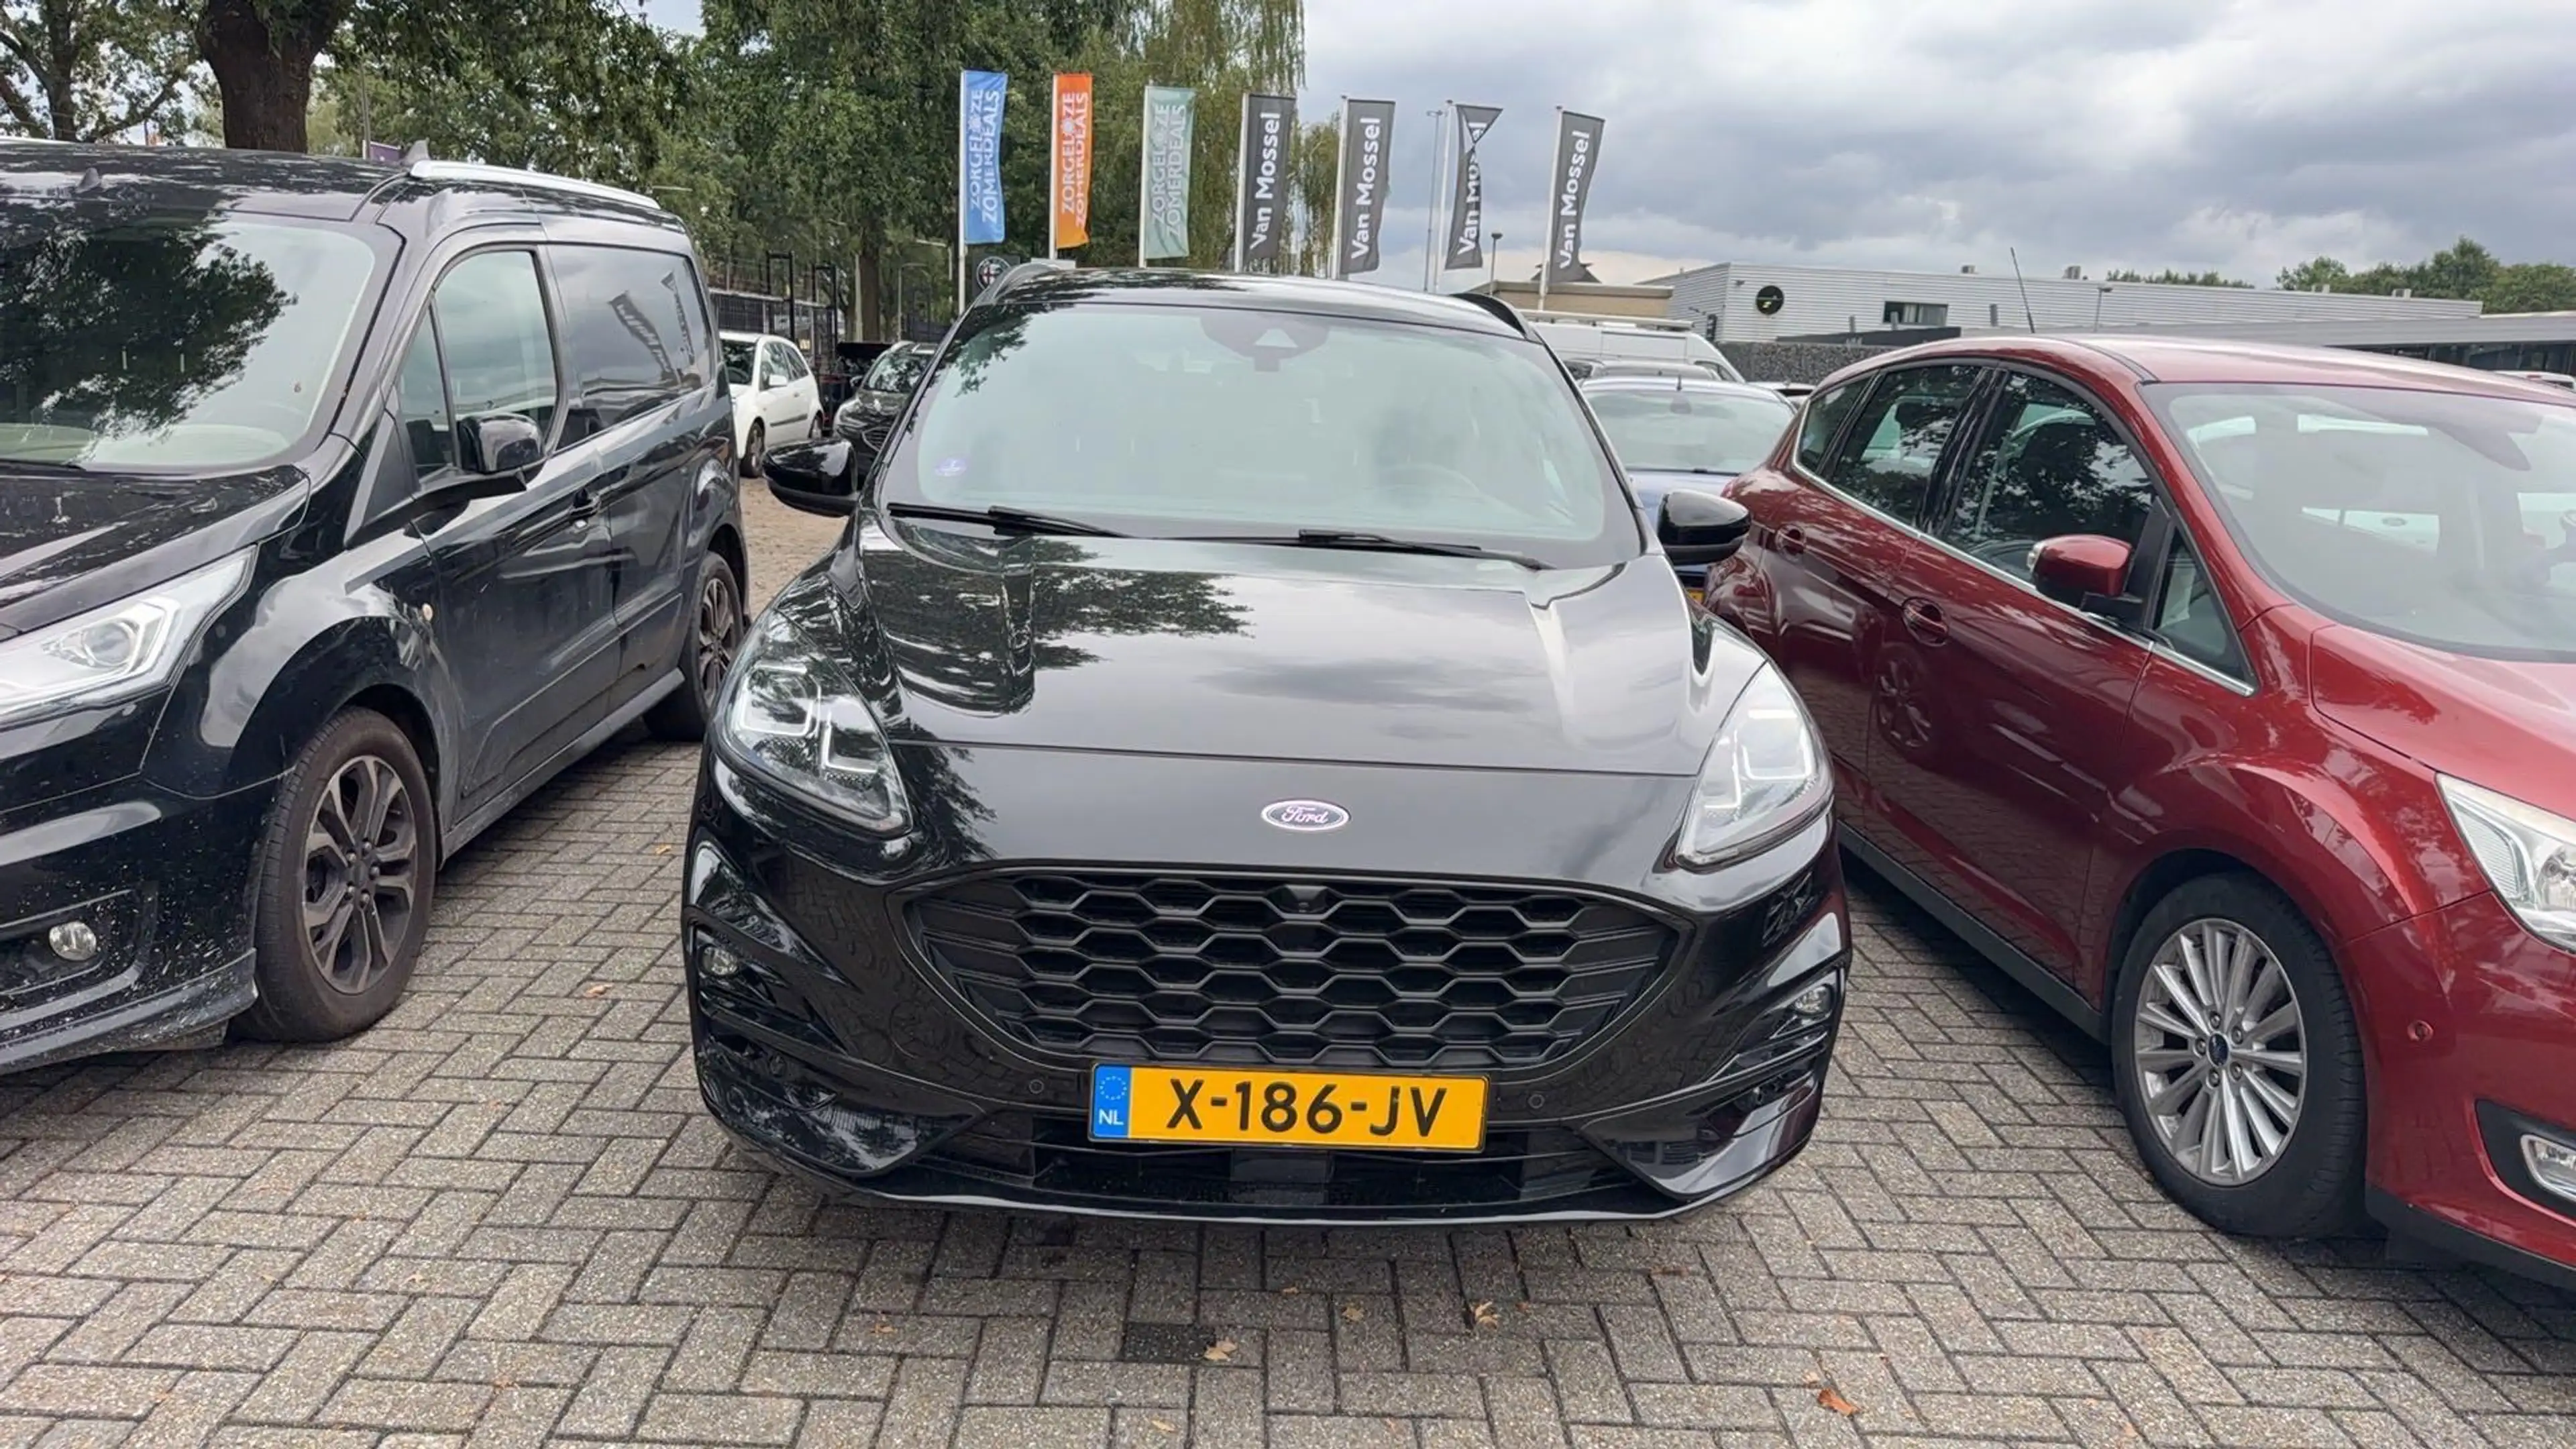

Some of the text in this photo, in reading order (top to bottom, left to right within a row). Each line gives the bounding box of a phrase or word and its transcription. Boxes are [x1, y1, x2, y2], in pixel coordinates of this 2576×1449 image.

[981, 91, 1000, 224] ZOMERDEALS
[1167, 105, 1186, 237] ZOMERDEALS
[1250, 112, 1281, 250] Van Mossel
[1350, 117, 1381, 259] Van Mossel
[1558, 130, 1591, 269] Van Mossel
[1457, 211, 1479, 255] Van
[1281, 806, 1329, 824] Ford
[1098, 1108, 1124, 1126] NL
[1166, 1078, 1448, 1137] X-186-JV
